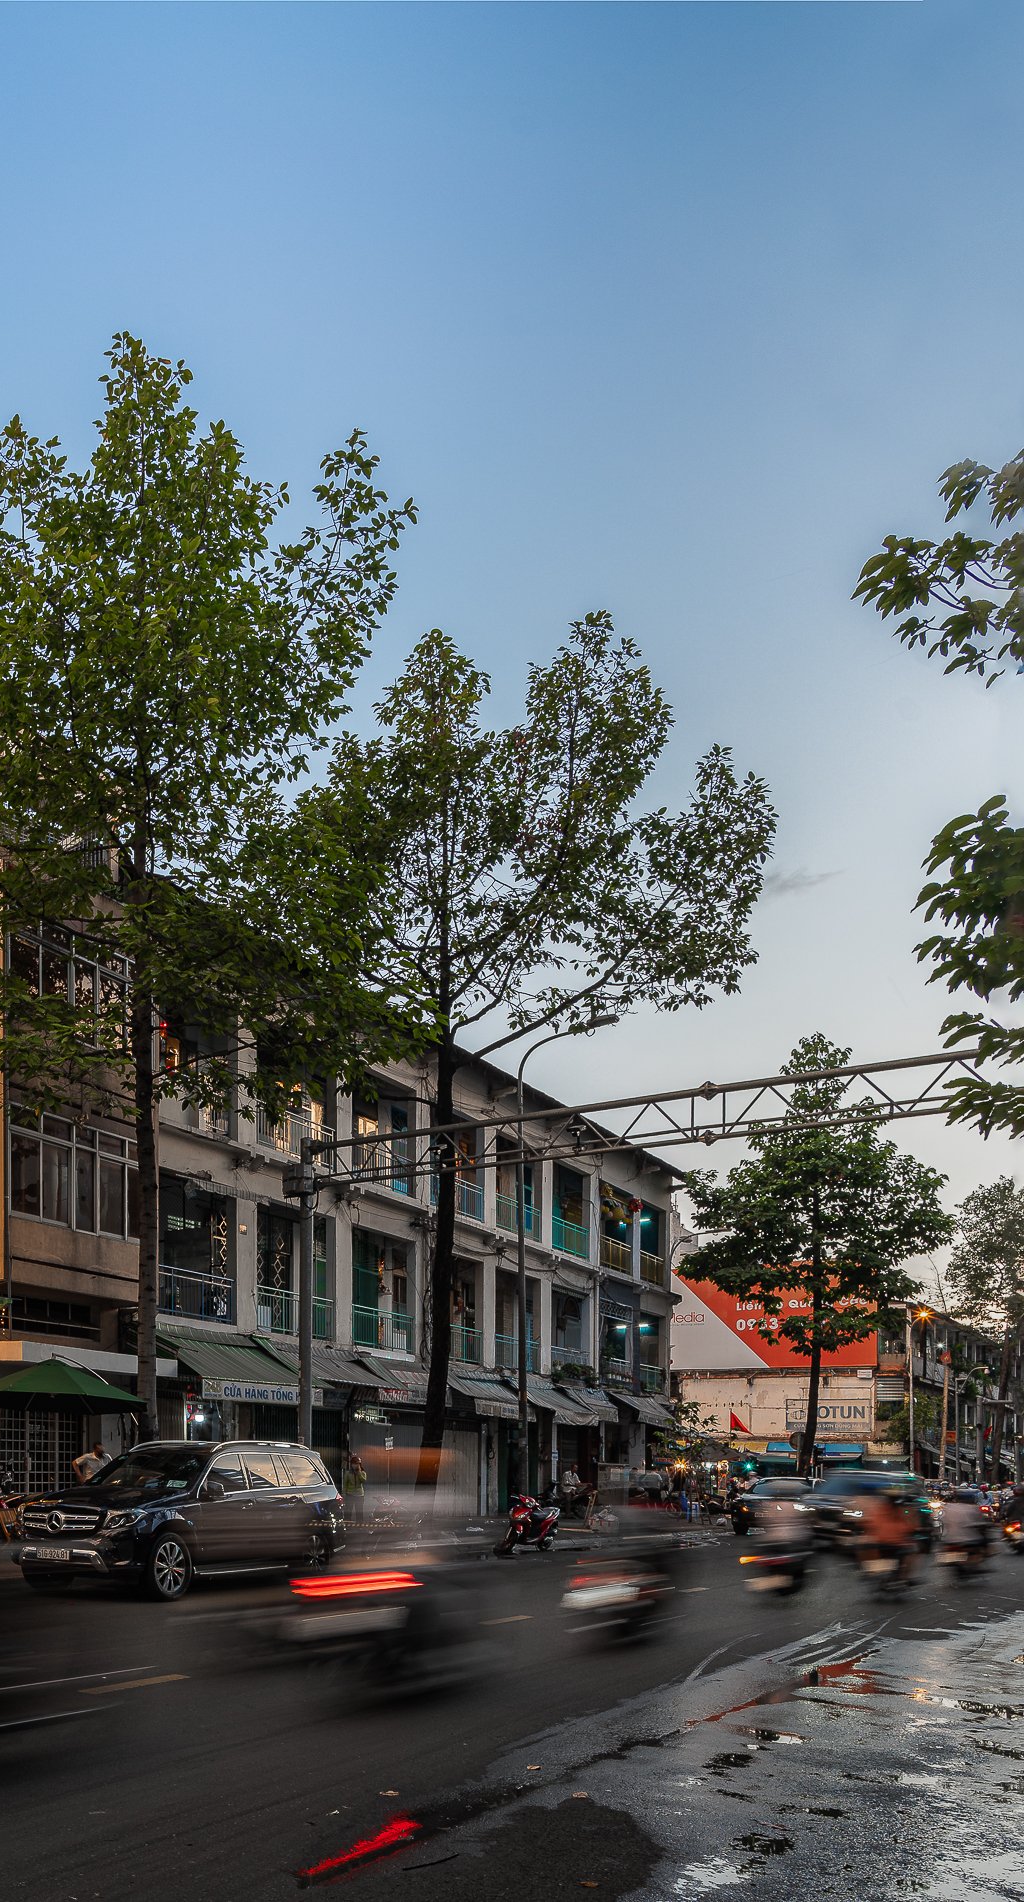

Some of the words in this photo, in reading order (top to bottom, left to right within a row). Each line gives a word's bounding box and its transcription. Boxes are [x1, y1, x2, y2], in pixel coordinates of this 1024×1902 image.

[224, 1383, 241, 1398] CỬA
[245, 1386, 268, 1400] HÀNG
[271, 1386, 293, 1401] TỔNG
[818, 1406, 865, 1419] OTUN
